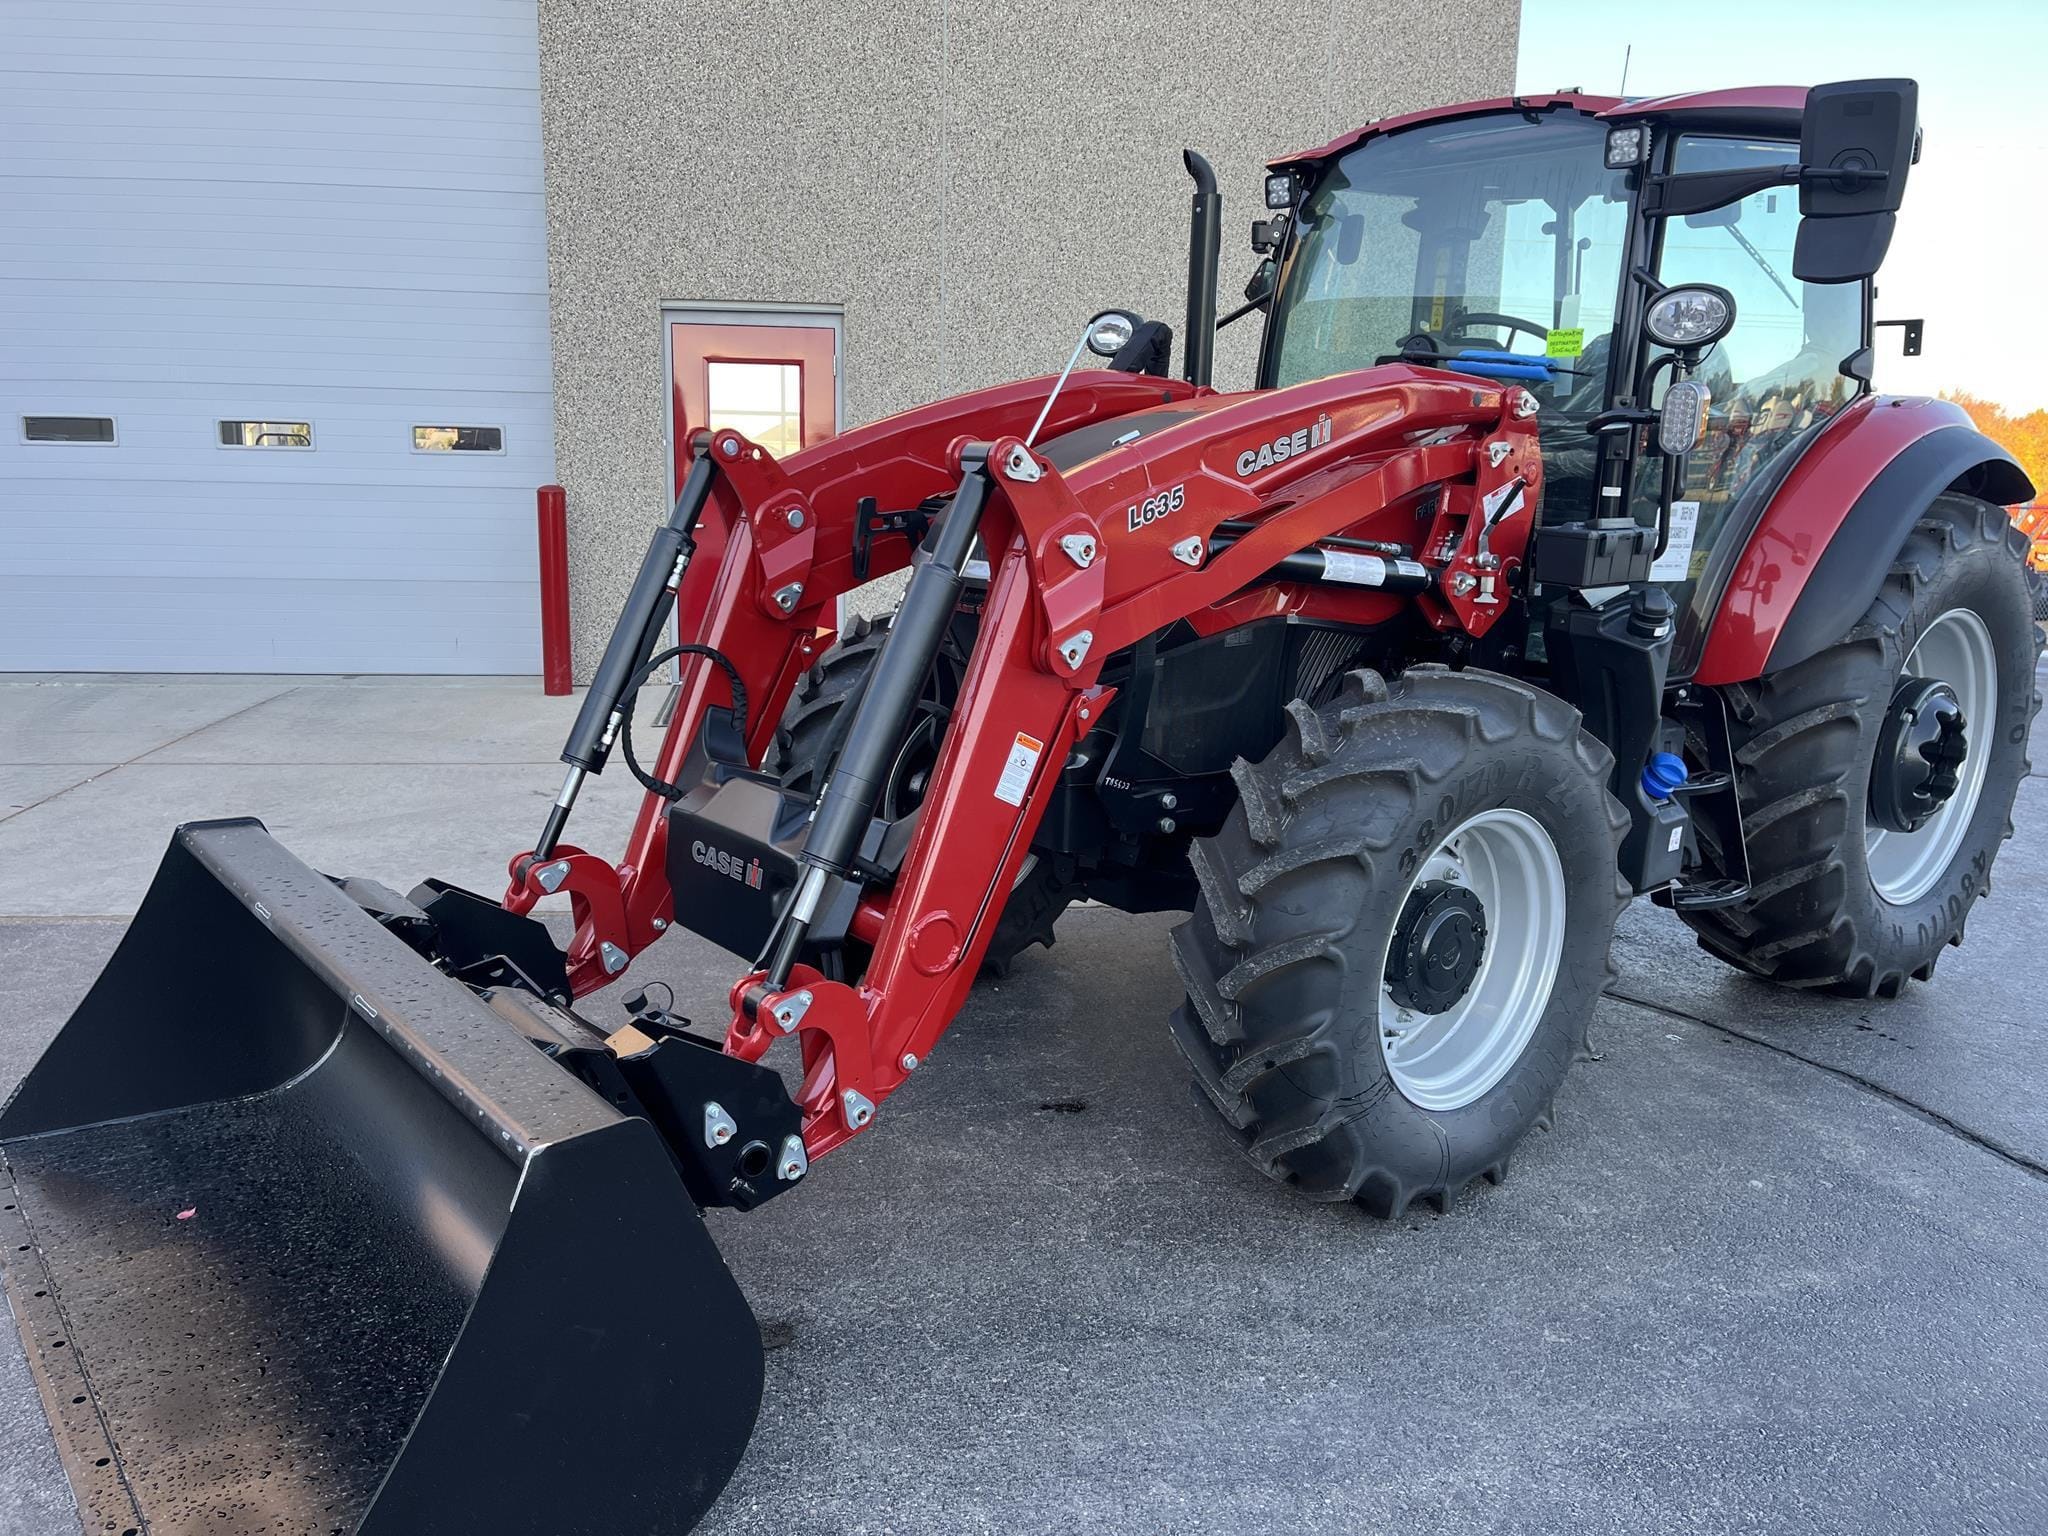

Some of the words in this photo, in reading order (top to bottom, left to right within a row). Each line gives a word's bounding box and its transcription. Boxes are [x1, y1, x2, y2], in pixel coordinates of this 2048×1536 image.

[1236, 428, 1308, 477] CASE
[1128, 483, 1185, 533] L635
[691, 840, 744, 882] CASE
